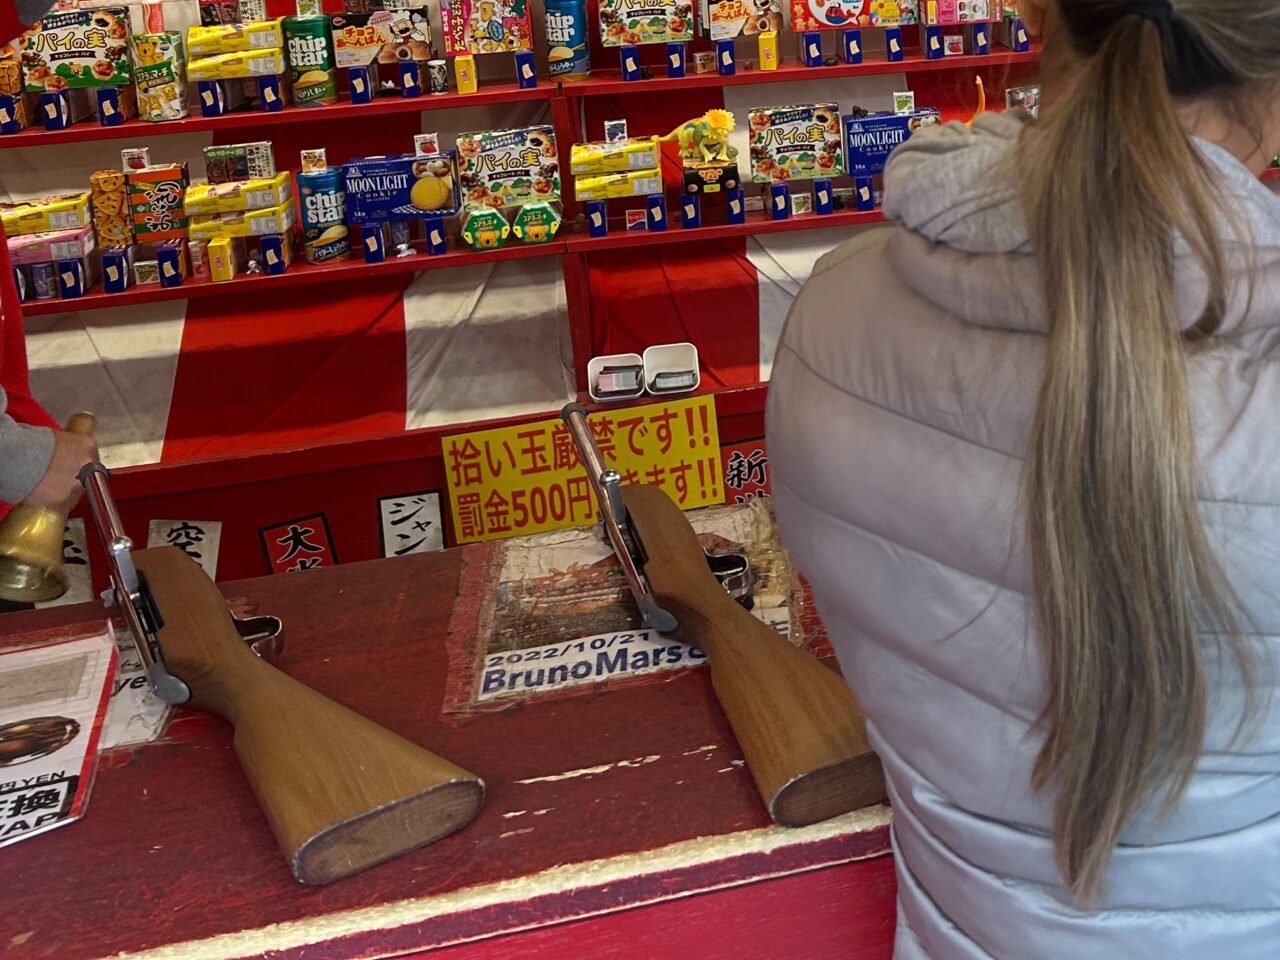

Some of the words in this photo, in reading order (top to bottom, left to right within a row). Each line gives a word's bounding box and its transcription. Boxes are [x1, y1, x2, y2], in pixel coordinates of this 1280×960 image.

[718, 1, 744, 13] チョコ
[36, 27, 108, 53] パイの実
[344, 26, 377, 39] チョコ
[288, 34, 327, 53] chip
[289, 49, 328, 66] star
[764, 125, 827, 146] パイの実
[850, 130, 905, 148] MOONLIGHT
[475, 147, 542, 172] パイの実
[346, 174, 409, 194] MOONLIGHT
[357, 190, 398, 198] Cookie
[305, 190, 345, 210] chip
[725, 450, 769, 504] 新
[389, 497, 432, 555] ジャン
[488, 632, 650, 668] 2022/10/21
[0, 788, 60, 819] 換
